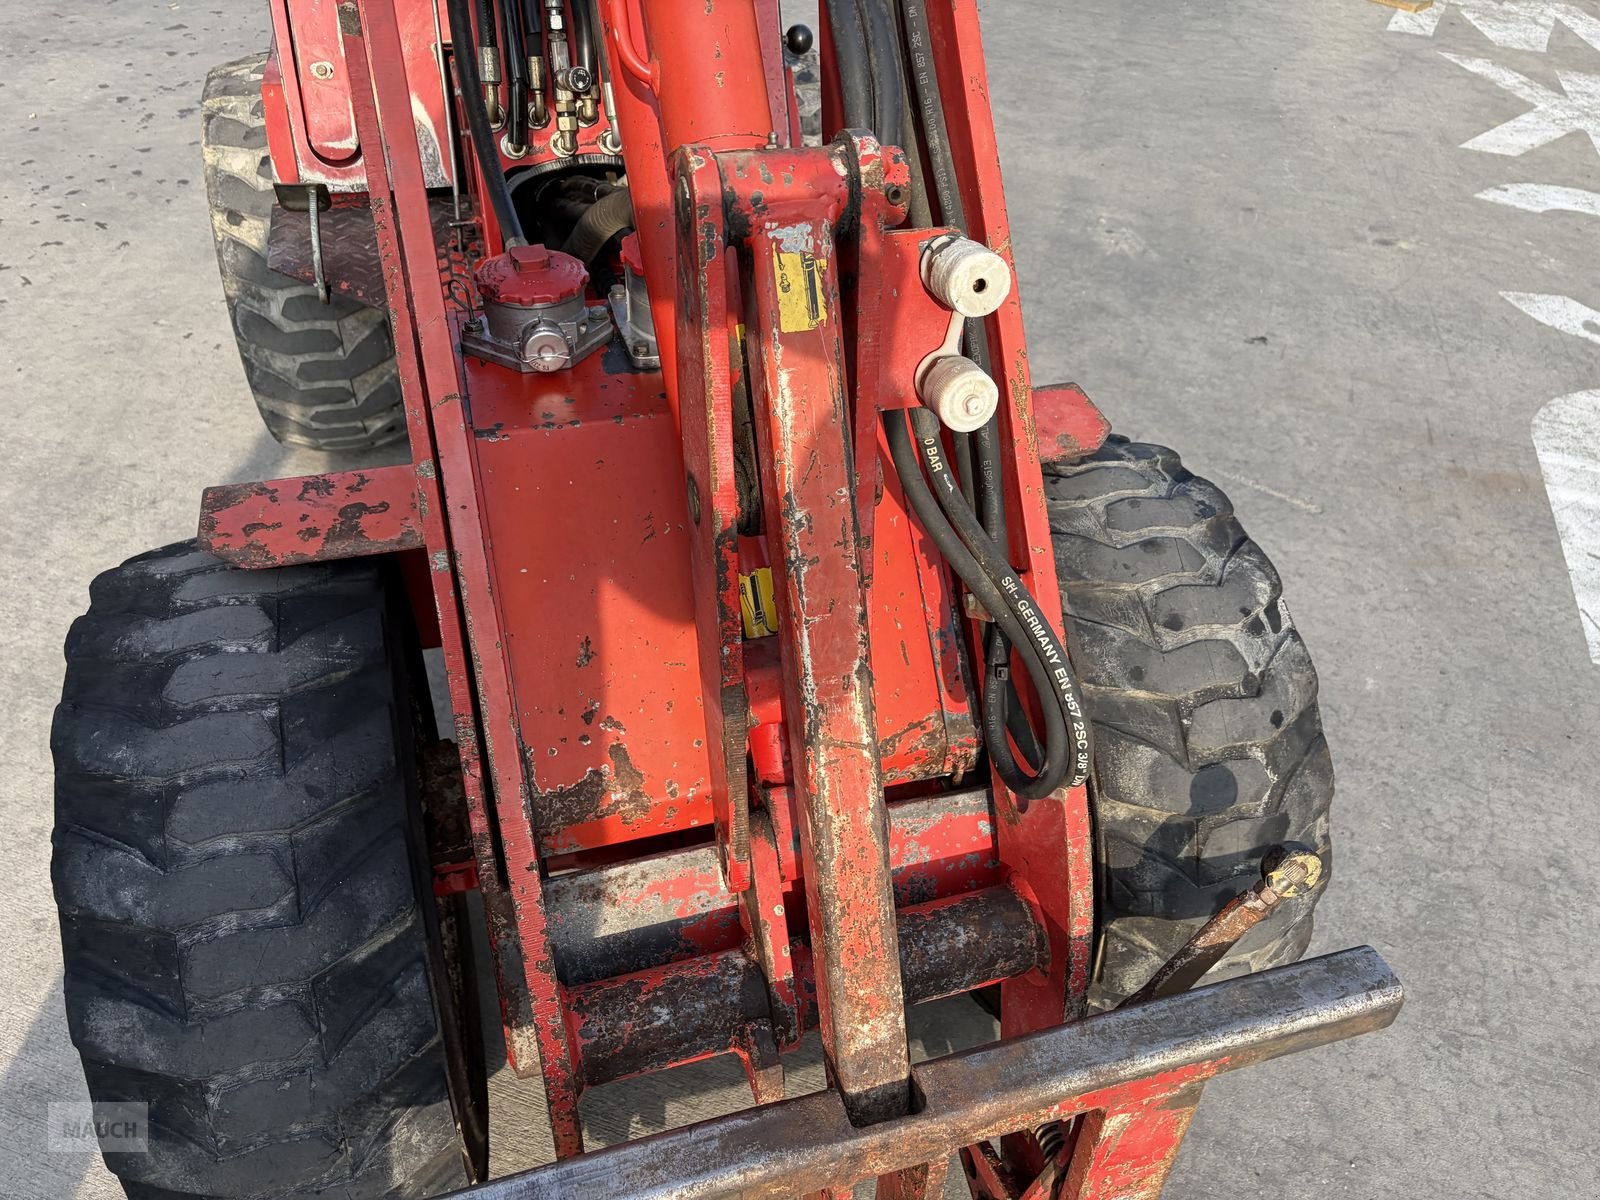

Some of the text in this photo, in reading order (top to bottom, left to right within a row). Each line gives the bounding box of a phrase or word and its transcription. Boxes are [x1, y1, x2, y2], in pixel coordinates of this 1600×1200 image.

[908, 6, 918, 18] DN
[912, 30, 922, 48] 2SC
[915, 52, 926, 68] 857
[919, 72, 929, 85] EN
[924, 97, 934, 115] R16
[926, 446, 943, 473] BAR
[1018, 600, 1062, 665] GERMANY
[1054, 667, 1072, 690] EN
[987, 692, 998, 704] EN
[1064, 692, 1082, 718] 857
[1073, 721, 1088, 750] 2SC
[1071, 775, 1086, 786] DN
